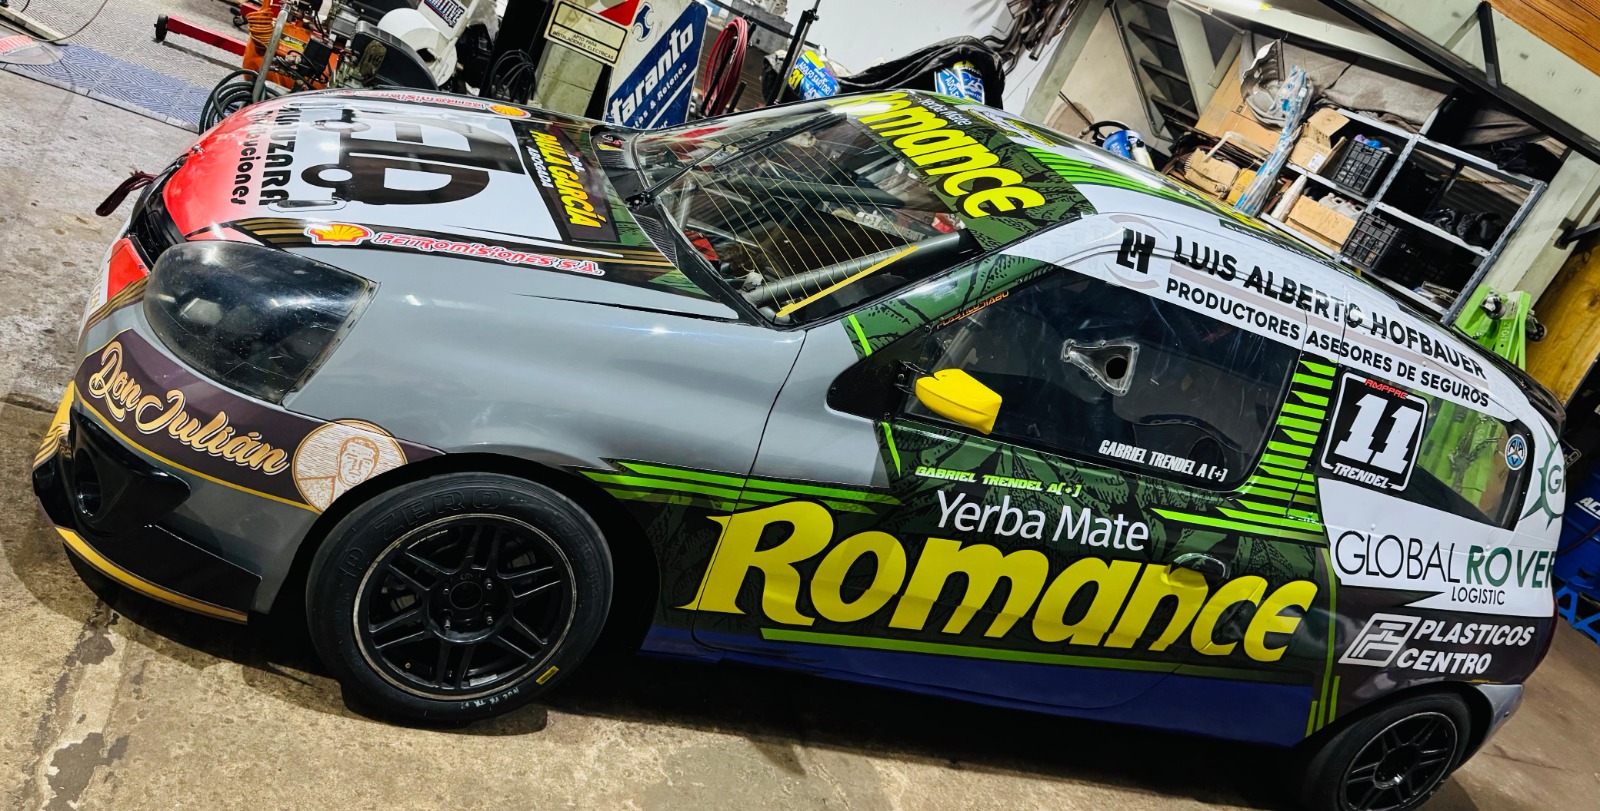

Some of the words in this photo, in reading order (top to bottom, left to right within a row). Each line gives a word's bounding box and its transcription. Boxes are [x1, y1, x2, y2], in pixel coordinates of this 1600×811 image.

[572, 33, 585, 42] APTO
[585, 38, 597, 48] PARA
[610, 23, 694, 125] taranto
[788, 68, 804, 90] 31
[528, 129, 573, 167] PAULA
[547, 165, 607, 228] GARCÍA
[1172, 235, 1238, 282] LUIS
[1243, 265, 1364, 328] ALBERTO
[1370, 311, 1488, 380] HOFBAUER
[1166, 278, 1301, 341] PRODUCTORES
[1306, 331, 1393, 373] ASESORES
[1396, 361, 1417, 382] DE
[1420, 370, 1490, 408] SEGUROS
[88, 340, 142, 422] Don
[134, 388, 290, 476] Julián
[1333, 393, 1422, 475] 11
[914, 465, 978, 483] GABRIEL
[982, 474, 1044, 491] TRENDEL
[1098, 439, 1148, 464] GABRIEL
[1147, 450, 1196, 476] TRENDEL
[1195, 463, 1208, 478] A
[1332, 462, 1390, 489] TRENDEL
[1548, 464, 1567, 495] G
[936, 489, 1046, 541] Yerba
[1051, 504, 1149, 551] Mate
[1335, 530, 1461, 584] GLOBAL
[676, 500, 1318, 663] Romance
[1451, 586, 1506, 606] LOGISTIC
[1414, 619, 1535, 647] PLASTICOS
[1396, 647, 1493, 675] CENTRO
